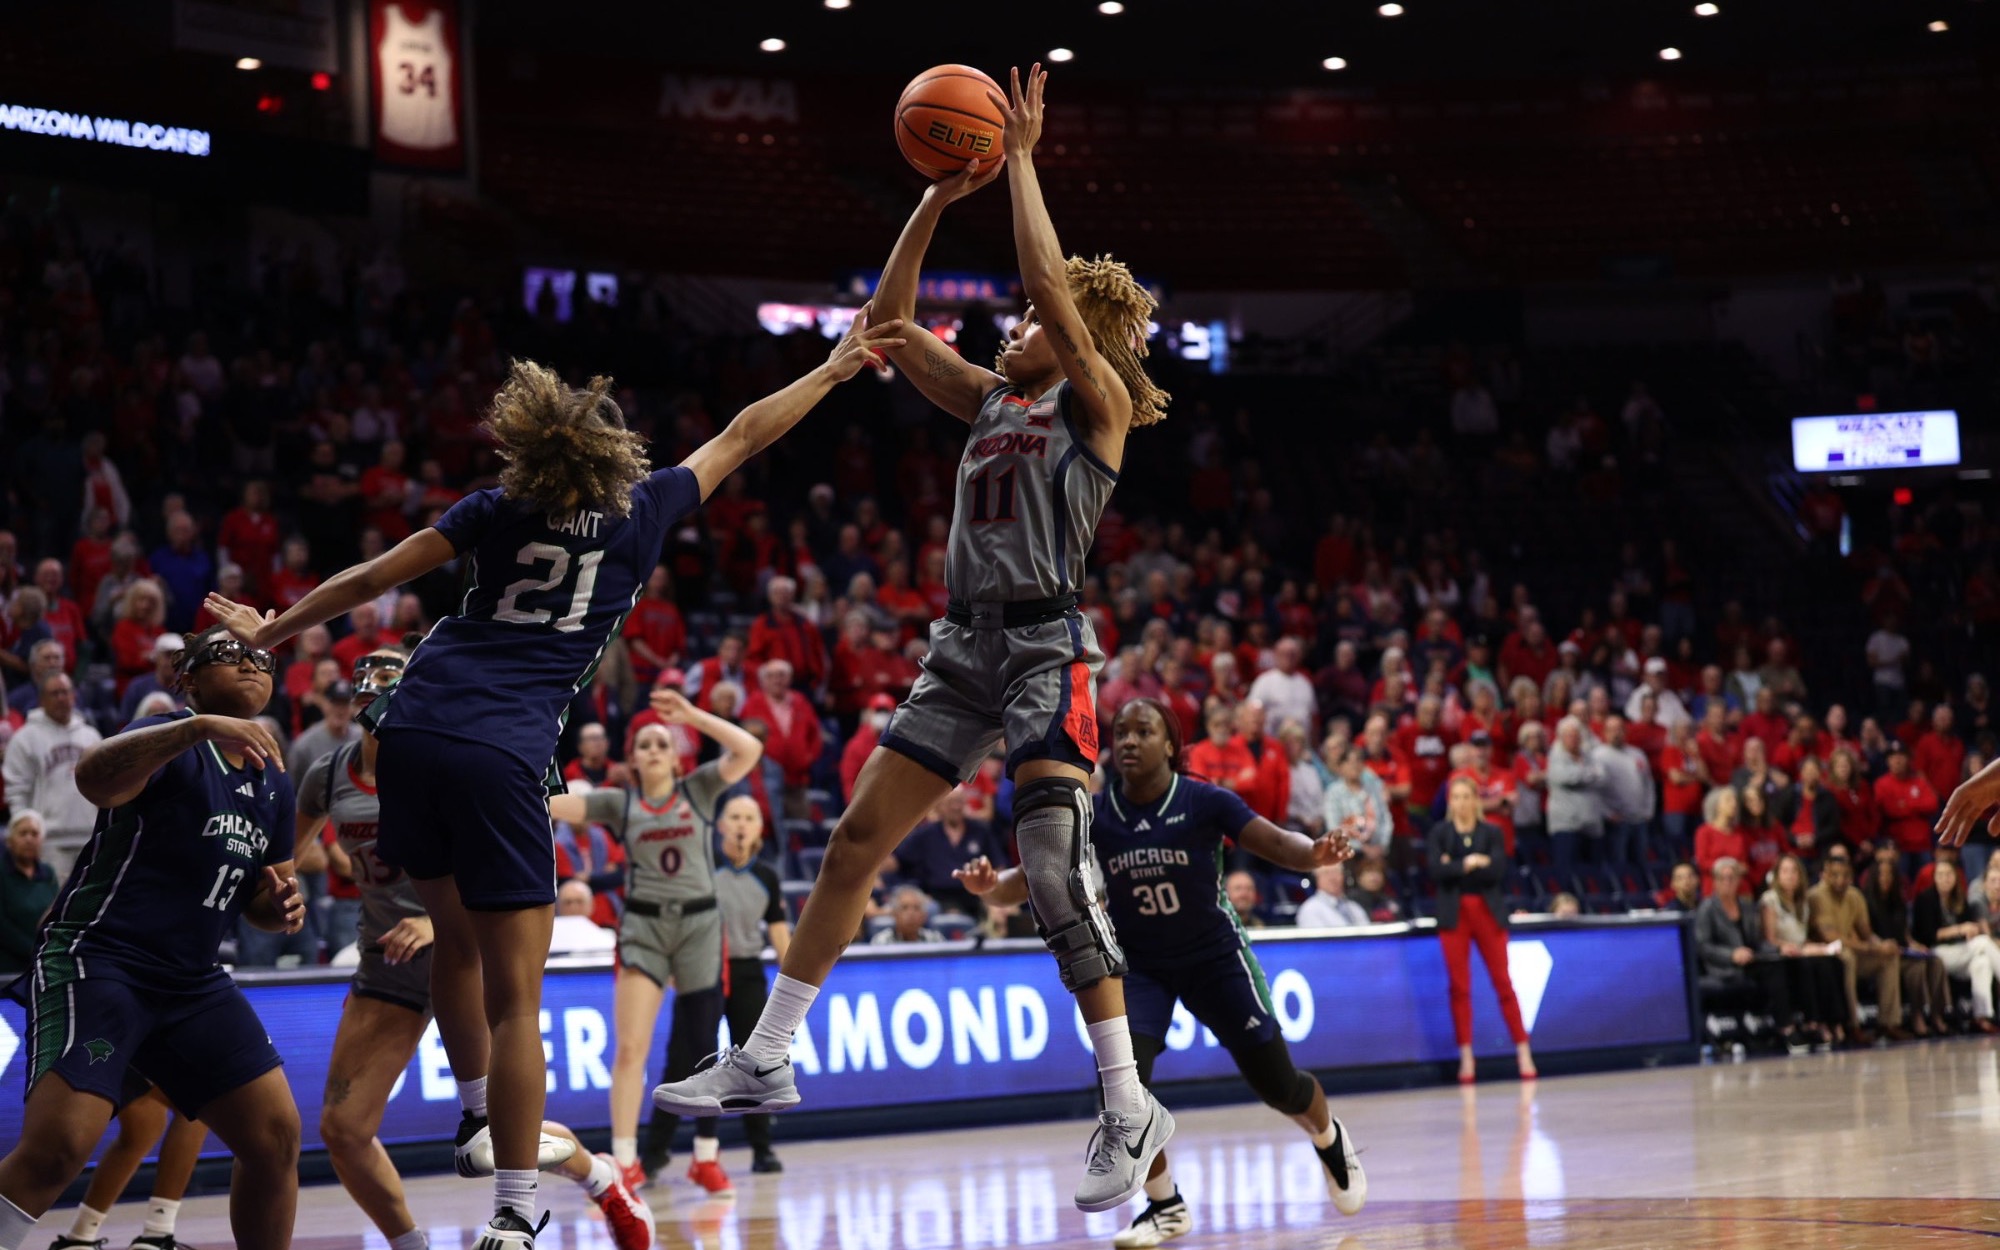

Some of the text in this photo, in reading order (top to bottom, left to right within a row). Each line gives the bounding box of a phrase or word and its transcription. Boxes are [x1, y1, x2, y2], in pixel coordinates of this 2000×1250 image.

[399, 62, 436, 97] 34
[656, 72, 799, 124] NCAA
[928, 120, 993, 153] ELITE
[969, 464, 1017, 524] 11
[492, 541, 605, 633] 21
[226, 837, 254, 859] STATE
[661, 846, 681, 876] 0
[1108, 848, 1190, 876] CHICAGO
[202, 864, 246, 911] 13
[1130, 866, 1167, 880] STATE
[1132, 881, 1181, 915] 30
